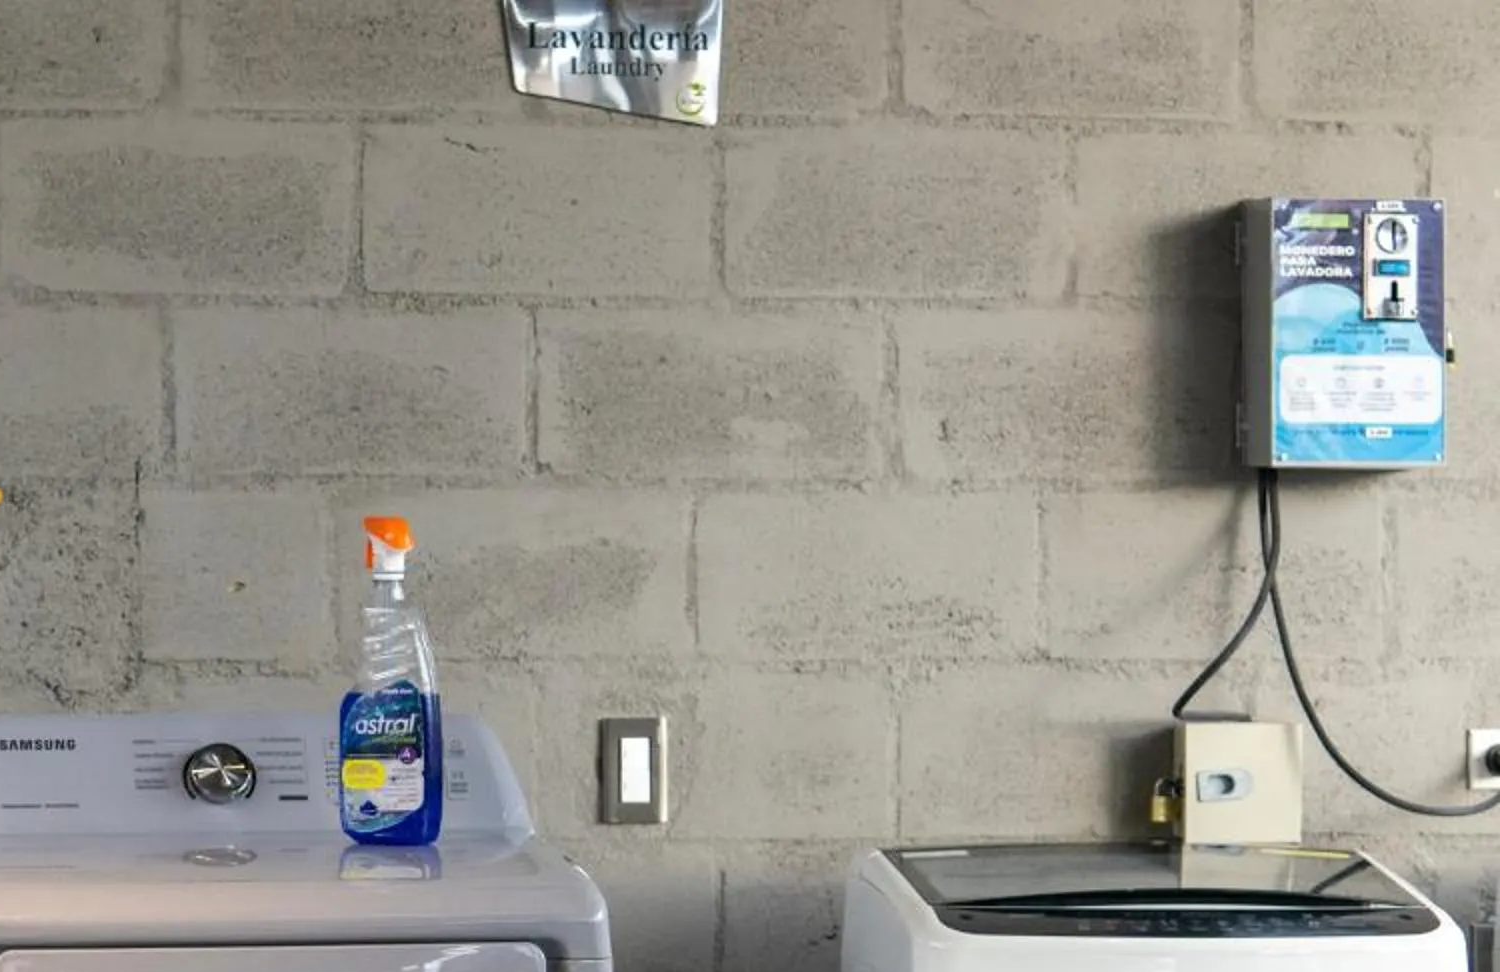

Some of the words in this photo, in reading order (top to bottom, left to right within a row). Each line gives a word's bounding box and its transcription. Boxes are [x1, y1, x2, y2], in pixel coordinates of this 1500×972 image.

[528, 22, 709, 51] Lavandería
[570, 57, 667, 82] Laundry
[1279, 244, 1356, 257] MONEDERO
[1279, 256, 1317, 266] PARA
[1279, 266, 1353, 278] LAVADORA
[354, 713, 416, 735] astral
[0, 738, 77, 752] SAMSUNG
